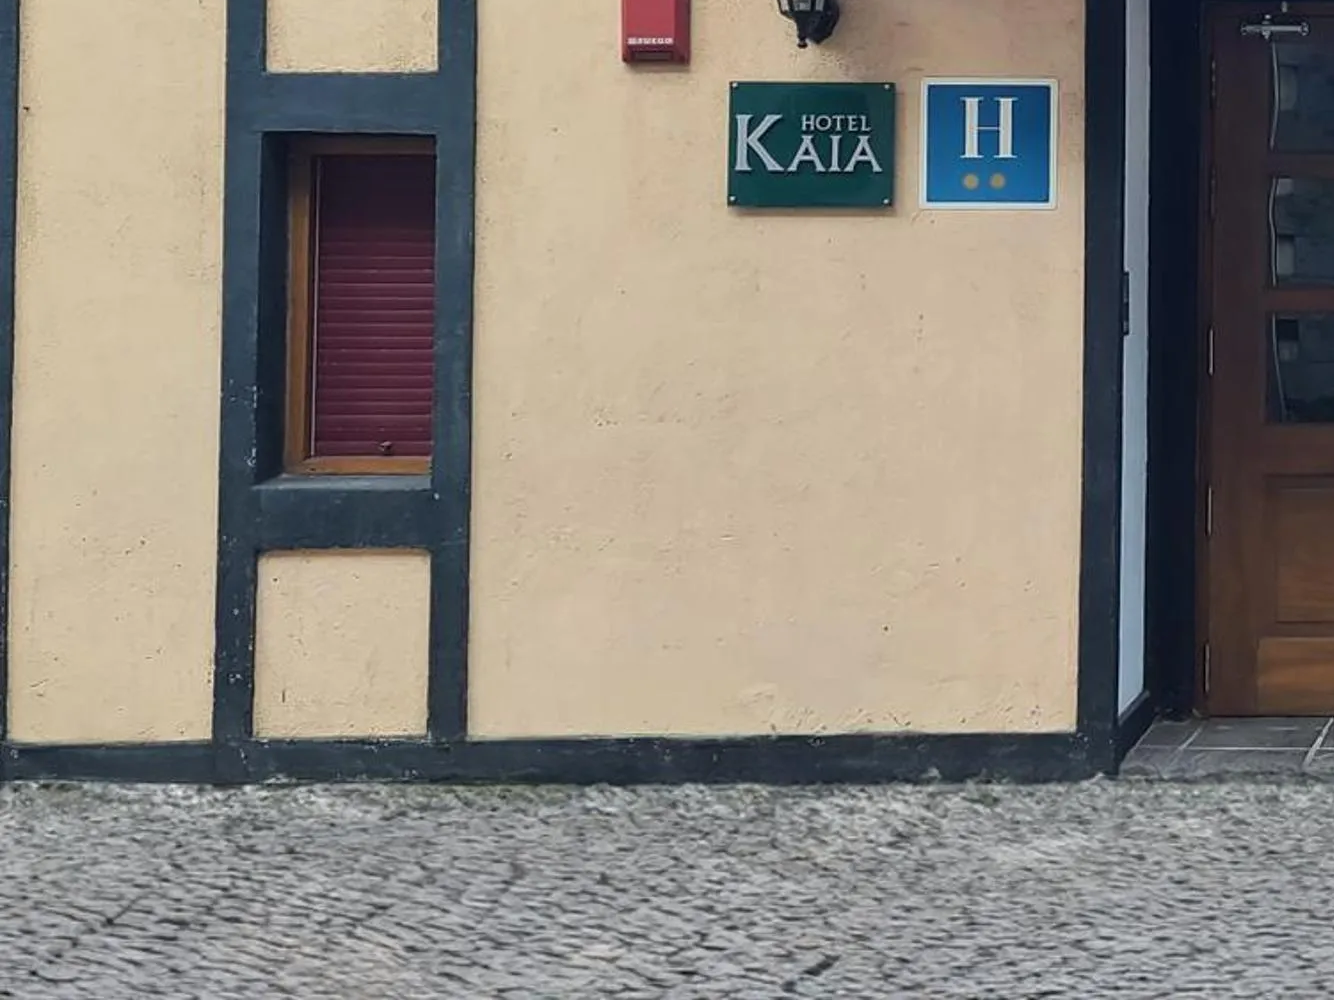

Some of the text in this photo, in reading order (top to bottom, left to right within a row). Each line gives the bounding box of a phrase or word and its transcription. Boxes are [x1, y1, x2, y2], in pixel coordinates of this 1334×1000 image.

[734, 114, 882, 172] KAIA
[802, 114, 871, 132] HOTEL
[960, 96, 1018, 159] H
